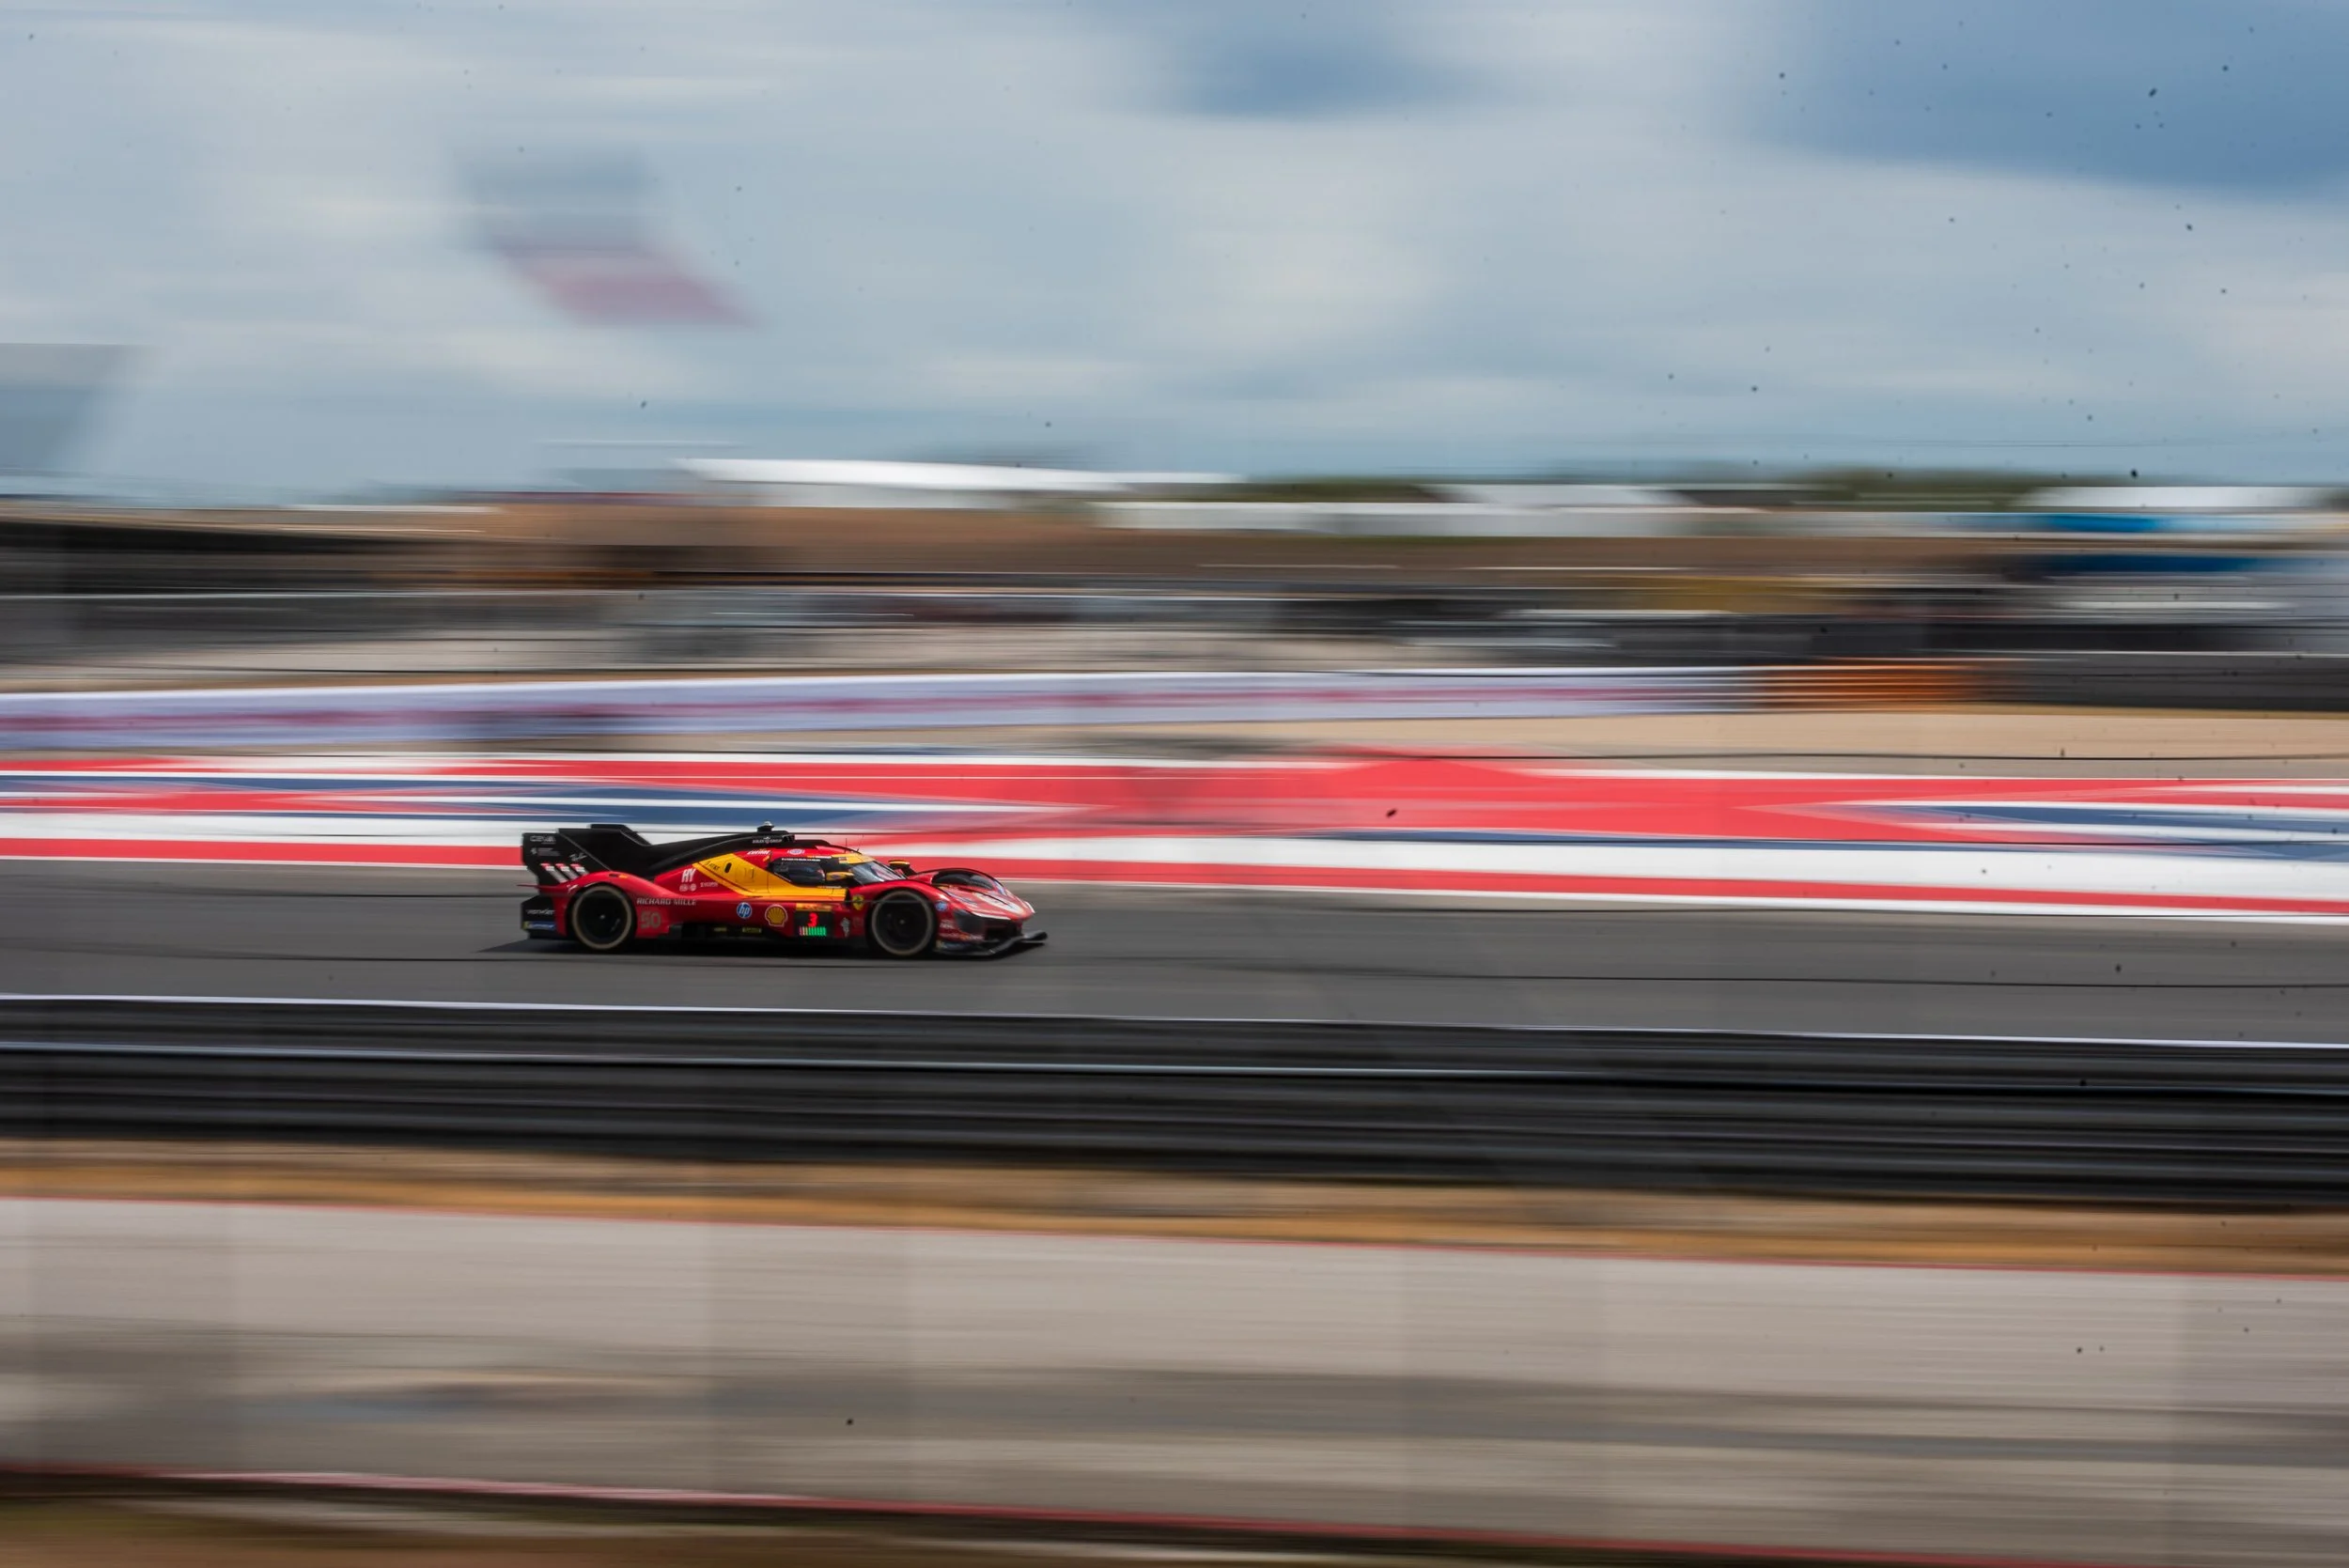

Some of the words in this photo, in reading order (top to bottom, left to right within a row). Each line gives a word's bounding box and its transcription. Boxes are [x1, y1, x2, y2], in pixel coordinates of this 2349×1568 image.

[636, 897, 671, 906] RICHARD
[674, 897, 696, 906] MILLE
[739, 903, 750, 918] hp
[641, 911, 661, 928] 50
[807, 912, 818, 927] 3
